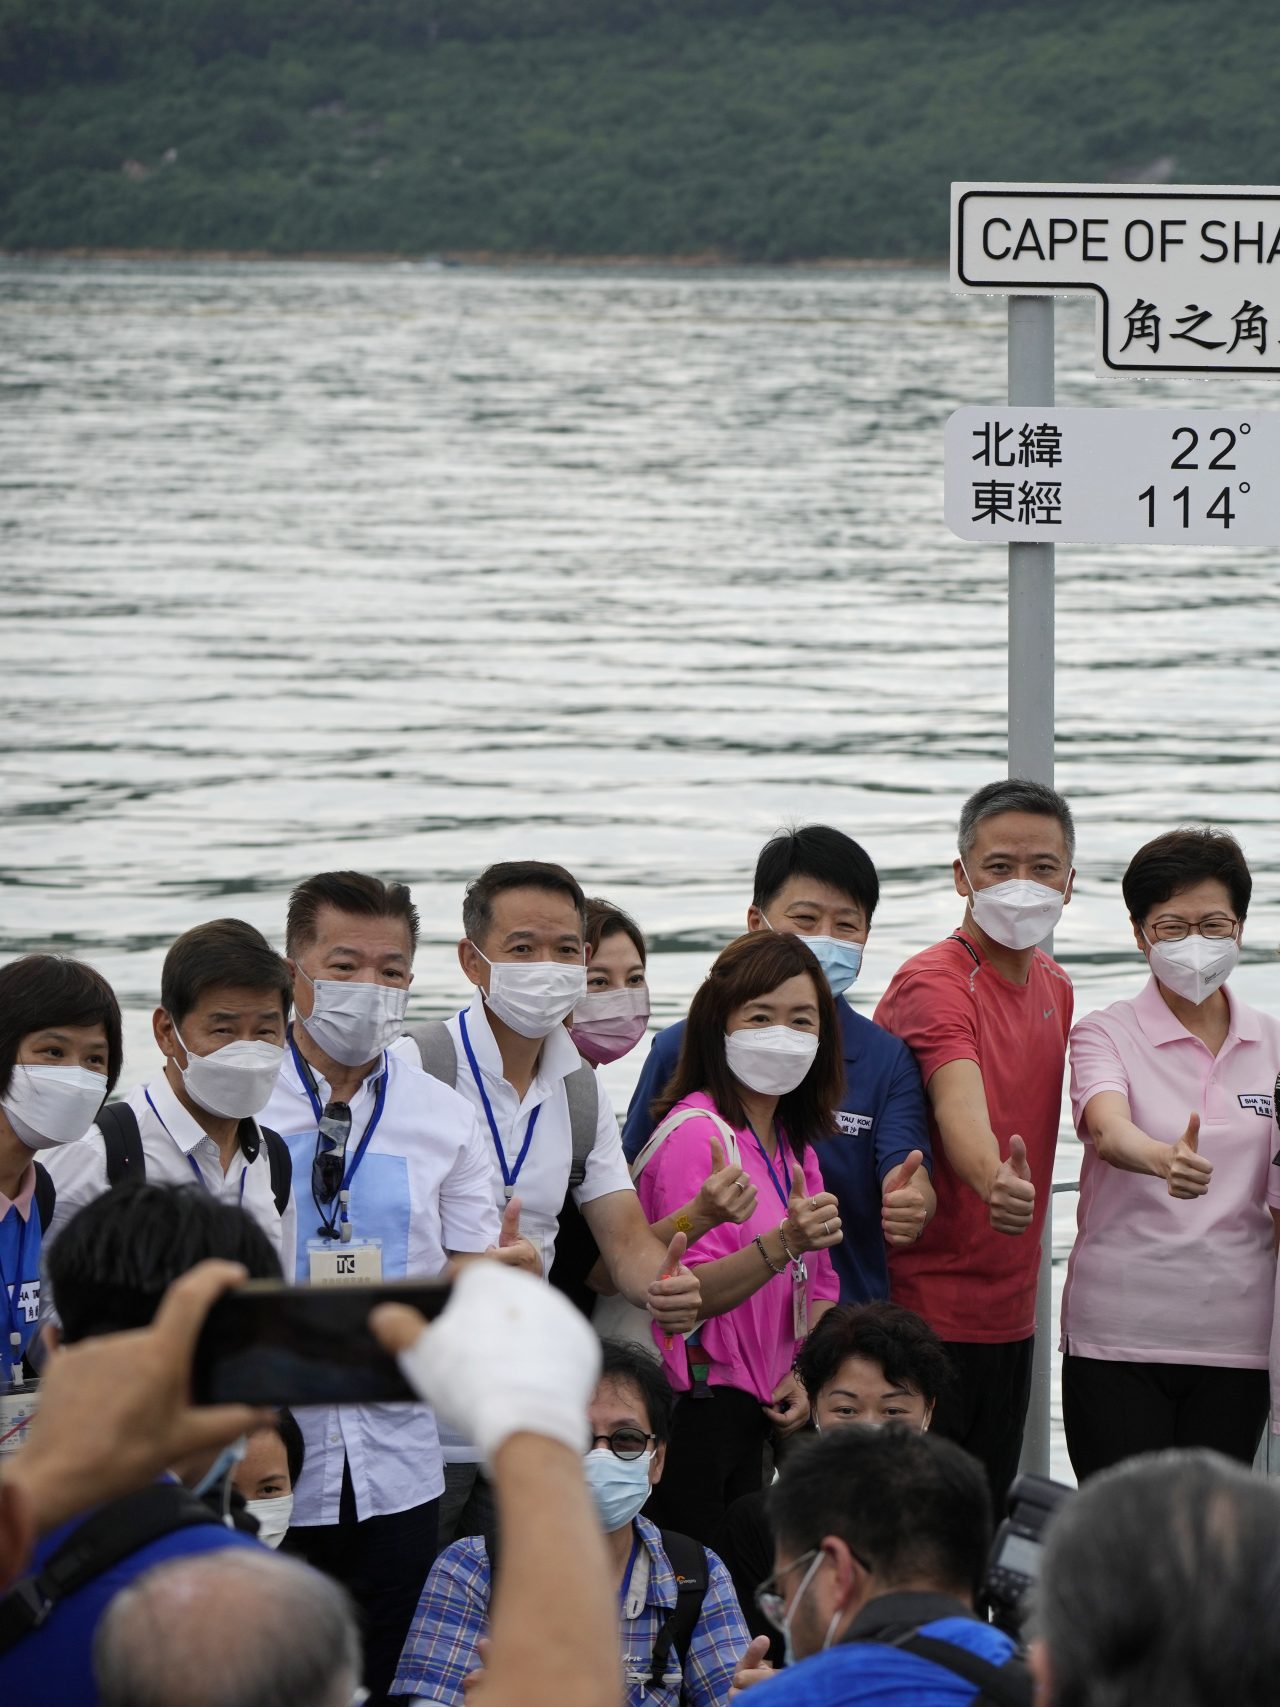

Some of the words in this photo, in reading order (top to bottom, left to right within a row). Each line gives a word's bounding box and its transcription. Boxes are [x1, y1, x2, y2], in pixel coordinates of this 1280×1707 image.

[982, 217, 1109, 261] CAPE
[1124, 219, 1186, 262] OF
[971, 421, 1063, 470] 北緯
[971, 479, 1063, 527] 東經
